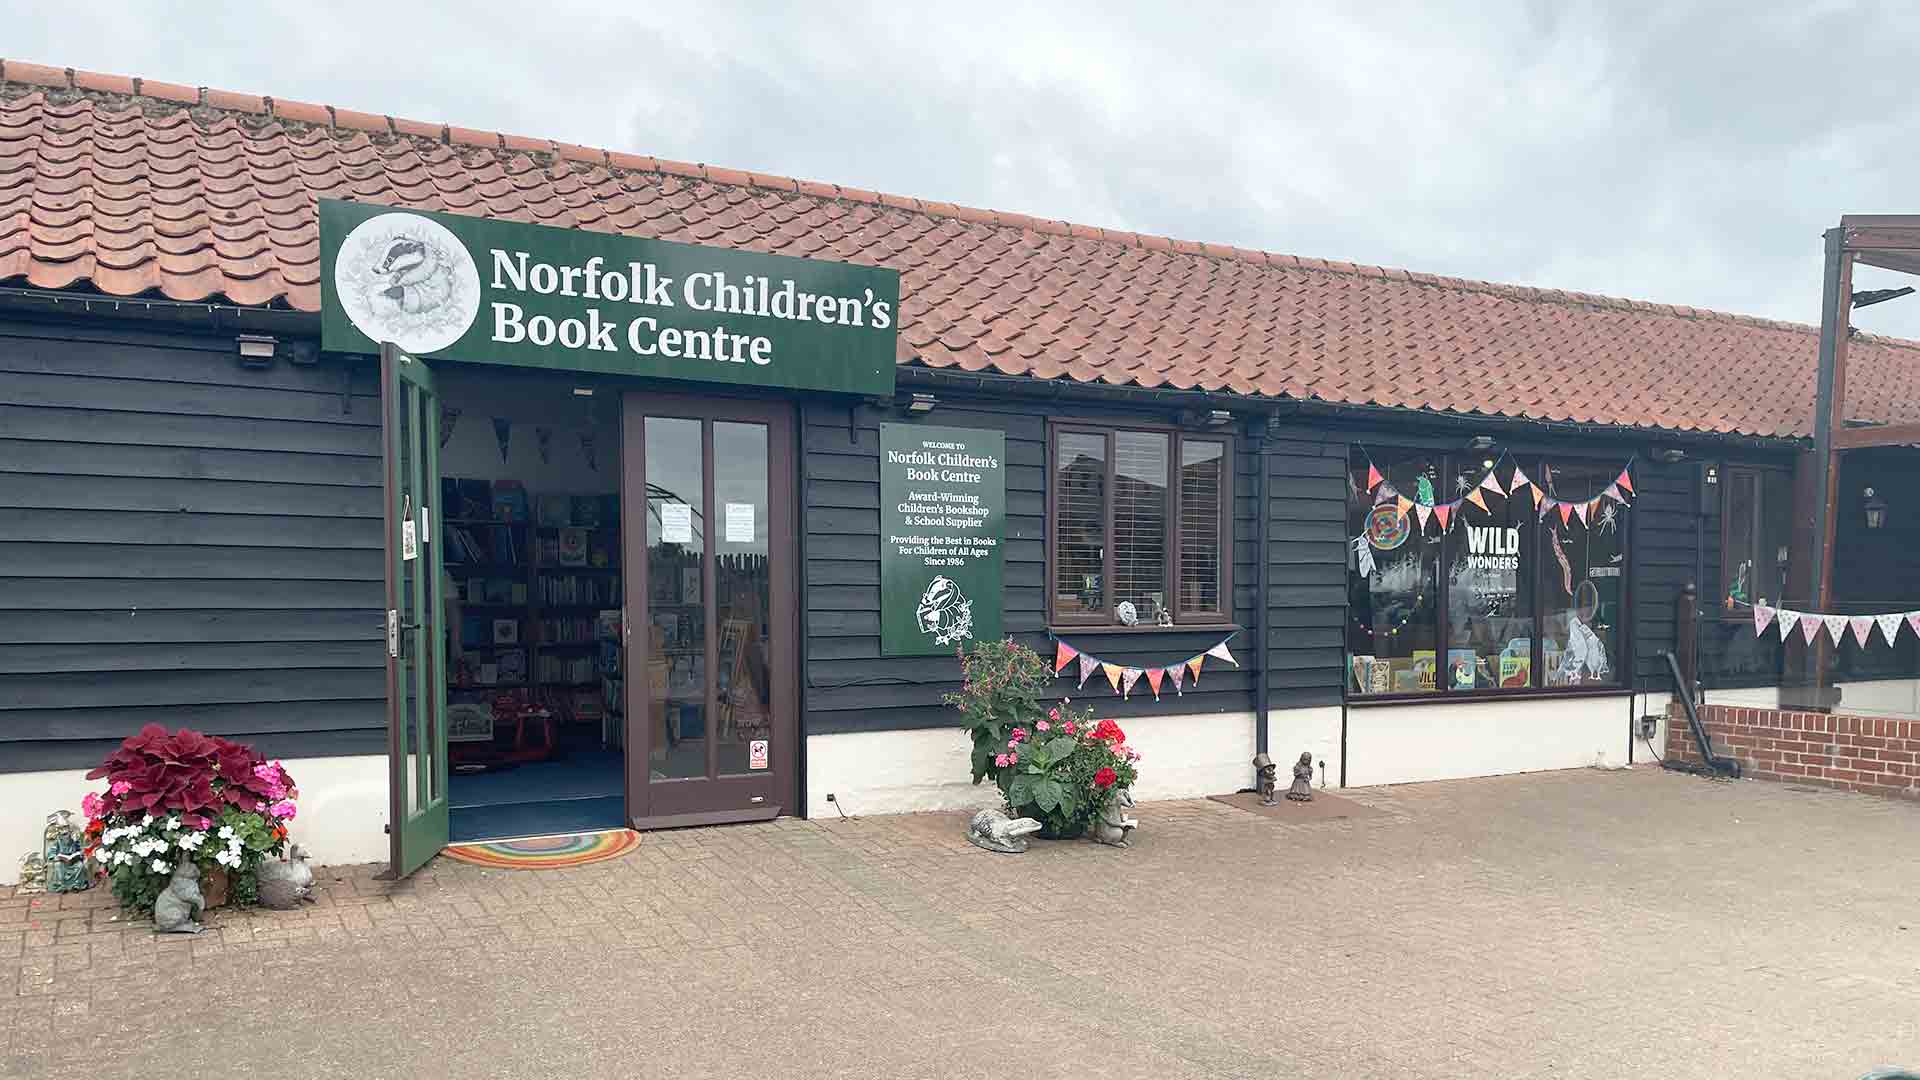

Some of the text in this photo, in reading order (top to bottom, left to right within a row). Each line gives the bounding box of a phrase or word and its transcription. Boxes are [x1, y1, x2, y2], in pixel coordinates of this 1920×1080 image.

[490, 249, 891, 329] Norfolk Children’s
[491, 302, 772, 365] Book Centre
[922, 441, 965, 450] WELCOME TO
[888, 450, 998, 468] Norfolk Children’s
[907, 467, 981, 483] Book Centre
[908, 491, 979, 505] Award-Winning
[897, 503, 989, 517] Children’s Bookshop
[905, 515, 983, 529] & School Supplier
[890, 535, 997, 546] Providing the Best in Books
[1466, 526, 1519, 554] WILD
[899, 546, 988, 558] For Children of All Ages
[924, 557, 965, 566] Since 1986
[1467, 556, 1519, 570] WONDERS
